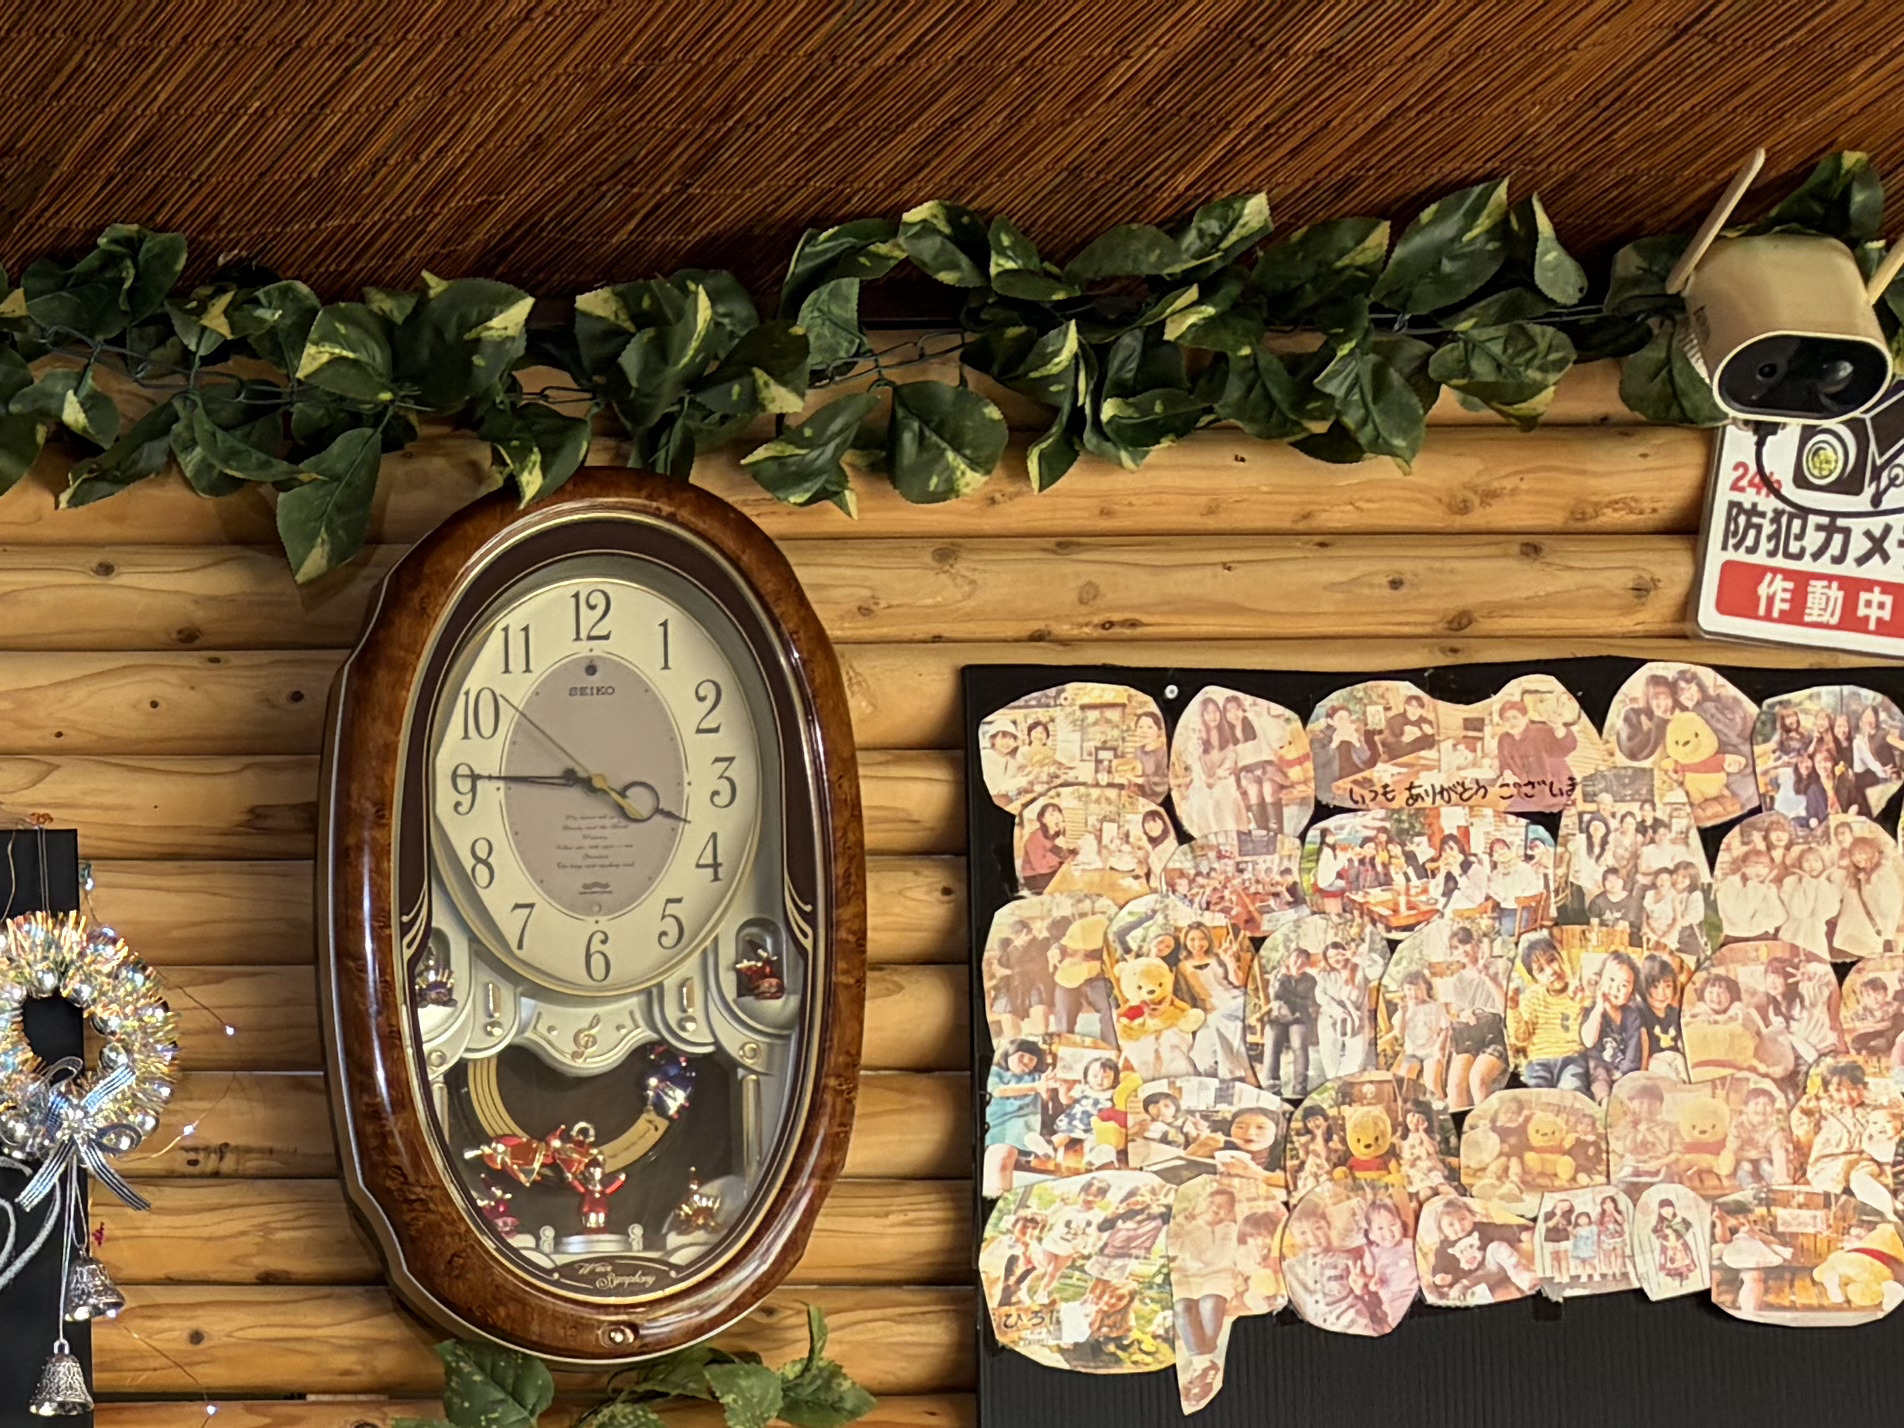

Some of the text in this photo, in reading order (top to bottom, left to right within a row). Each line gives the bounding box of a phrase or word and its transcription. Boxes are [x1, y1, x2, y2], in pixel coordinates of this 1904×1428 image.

[1720, 500, 1904, 568] 防犯カメ
[571, 588, 611, 641] 12
[1757, 572, 1894, 631] 作動中
[500, 625, 533, 675] 11
[659, 619, 670, 671] 1
[461, 688, 501, 740] 10
[568, 685, 616, 698] SEIKO
[694, 679, 721, 736] 2
[451, 763, 479, 816] 9
[710, 756, 737, 809] 3
[1349, 778, 1488, 807] いつも ありがとう
[470, 838, 495, 890] 8
[694, 832, 723, 883] 4
[510, 902, 537, 951] 7
[659, 897, 684, 950] 5
[584, 929, 611, 982] 6
